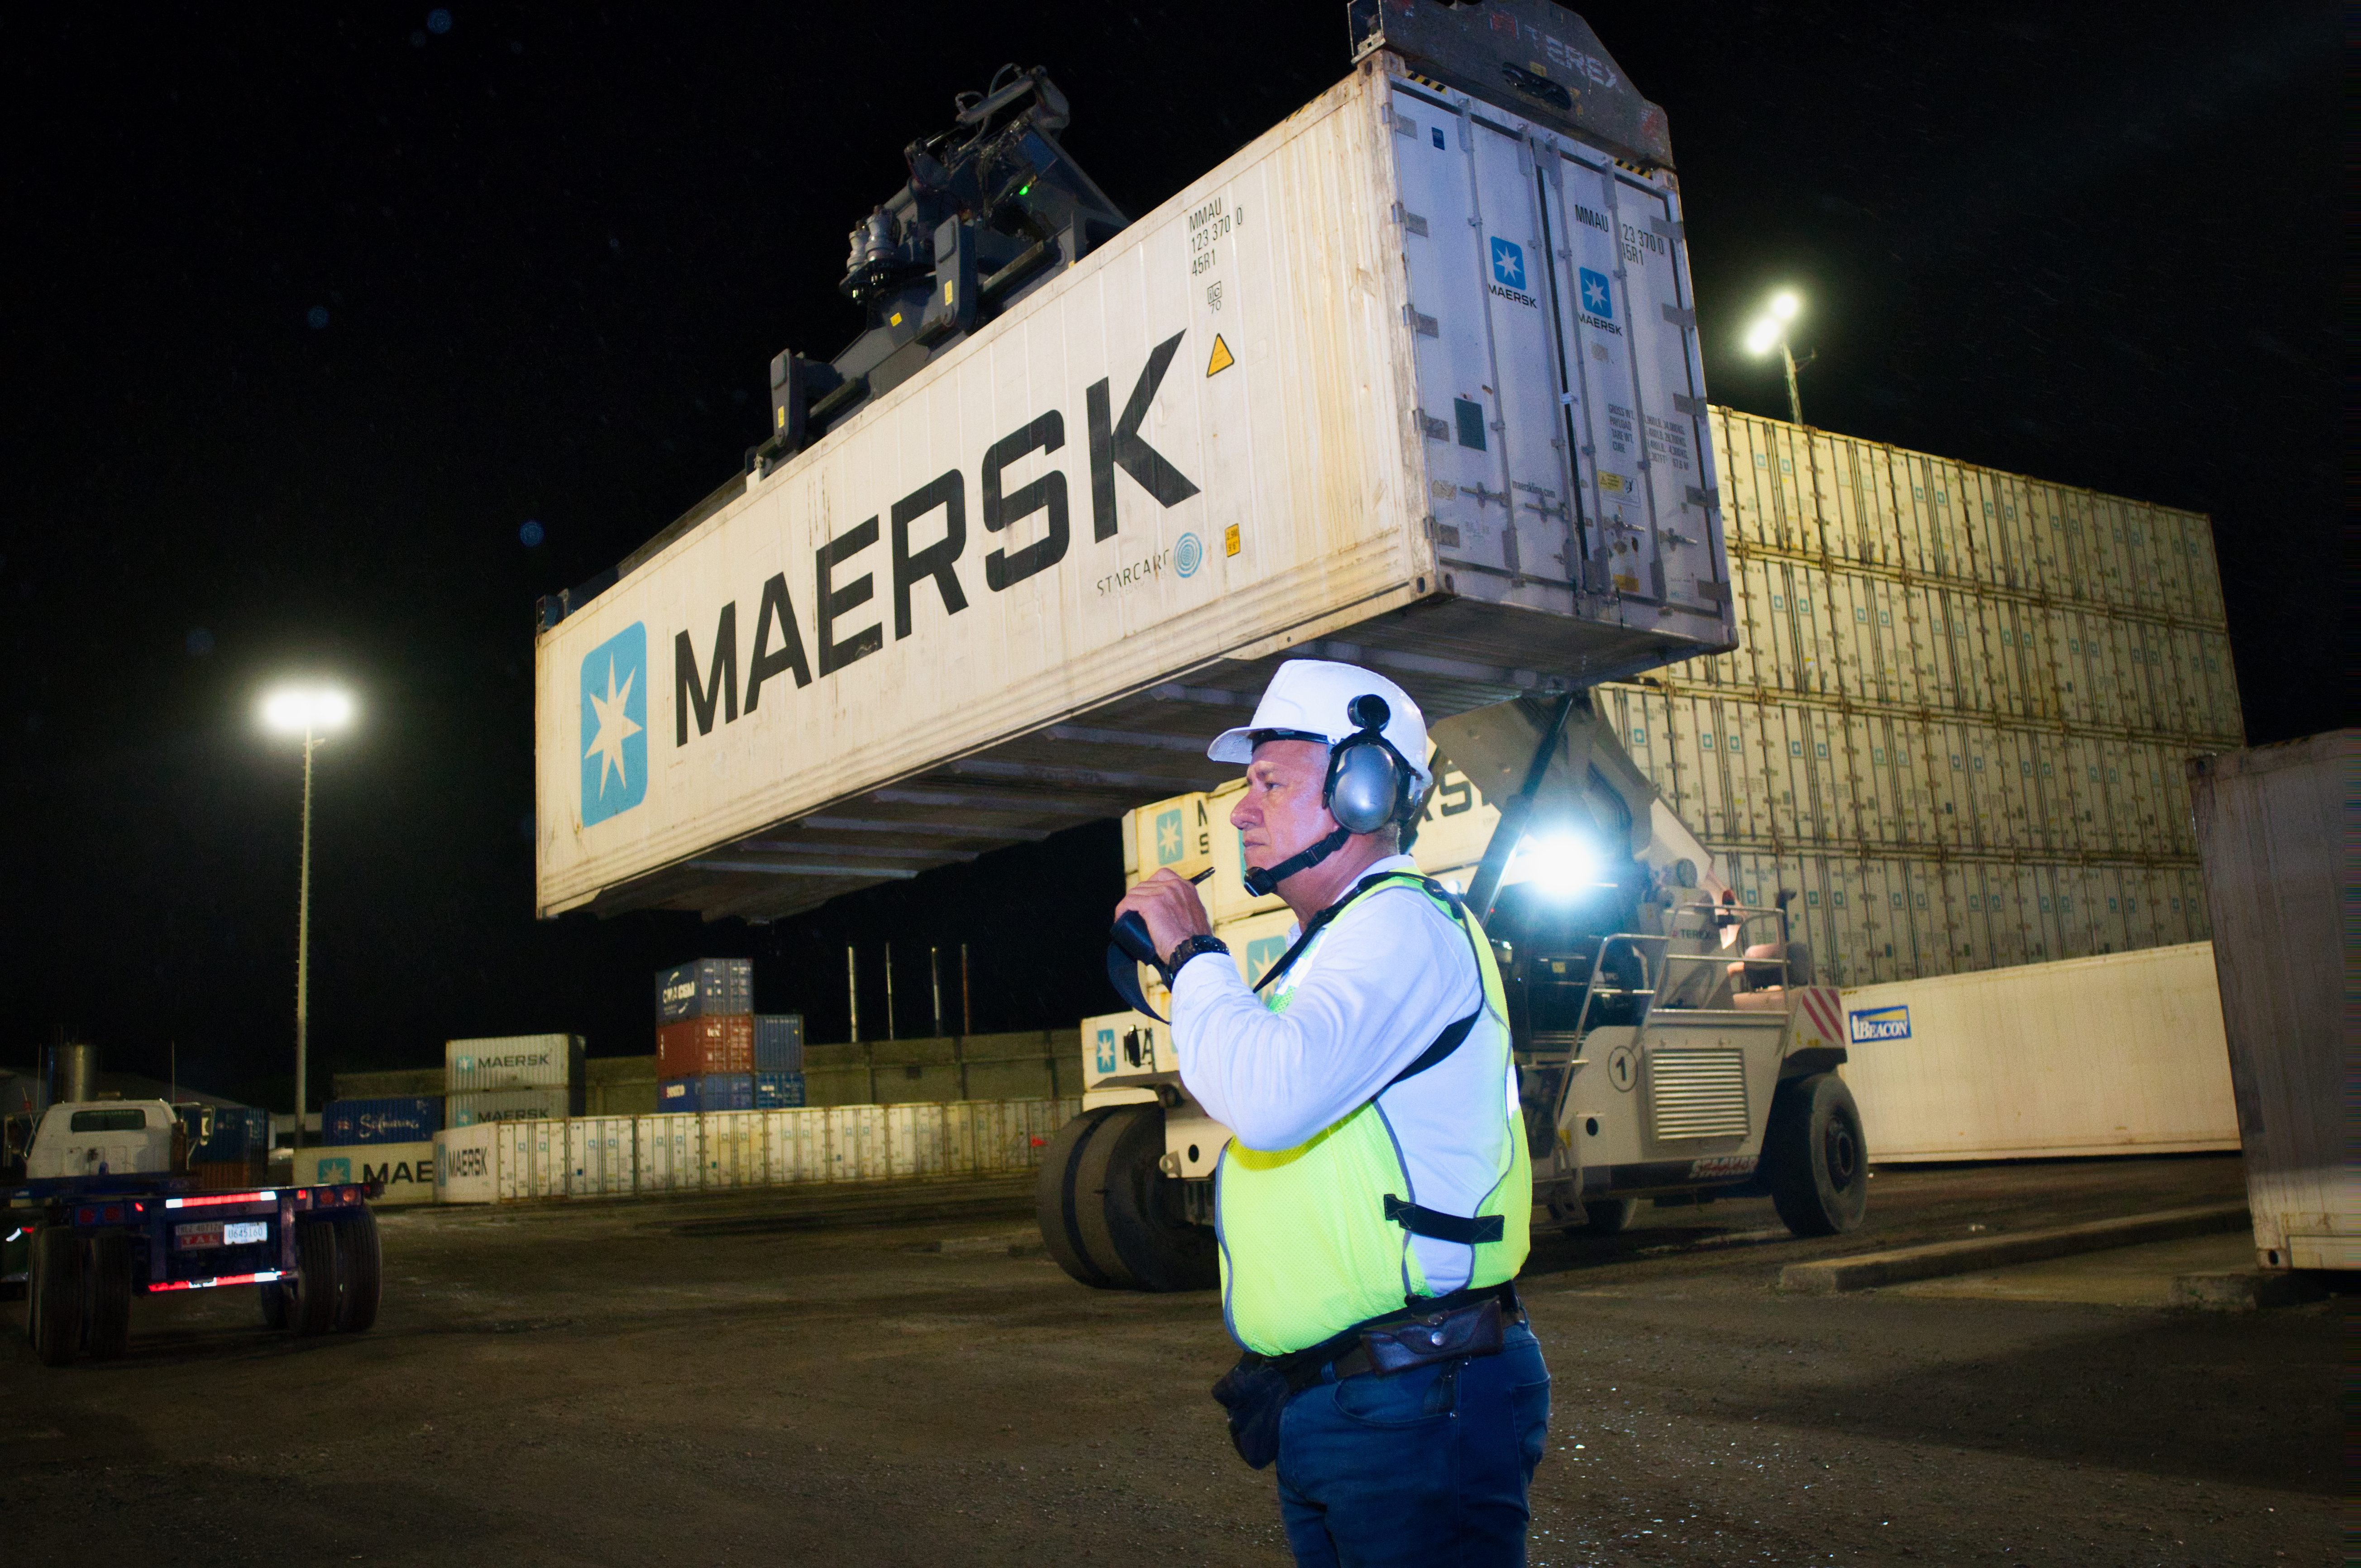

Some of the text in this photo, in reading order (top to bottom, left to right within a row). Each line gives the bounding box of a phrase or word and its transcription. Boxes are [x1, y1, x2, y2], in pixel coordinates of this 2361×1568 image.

[1190, 197, 1221, 232] MMAU
[1575, 204, 1609, 232] MMAU
[1191, 207, 1243, 253] 123 370 0
[1622, 224, 1664, 254] 23 370 0
[1192, 249, 1215, 276] 45R1
[1210, 300, 1221, 314] 70
[1488, 283, 1538, 309] MAERSK
[1578, 313, 1623, 336] MAERSK
[1608, 403, 1625, 417] GROSS
[1610, 416, 1632, 431] PAYLOAD
[675, 328, 1201, 747] MAERSK
[1860, 1020, 1907, 1038] BEACON
[478, 1054, 549, 1069] MAERSK
[1616, 1056, 1626, 1081] 1
[478, 1107, 549, 1123] MAERSK
[363, 1161, 433, 1185] MAE
[448, 1147, 487, 1177] MAERSK
[228, 1227, 263, 1239] U645160
